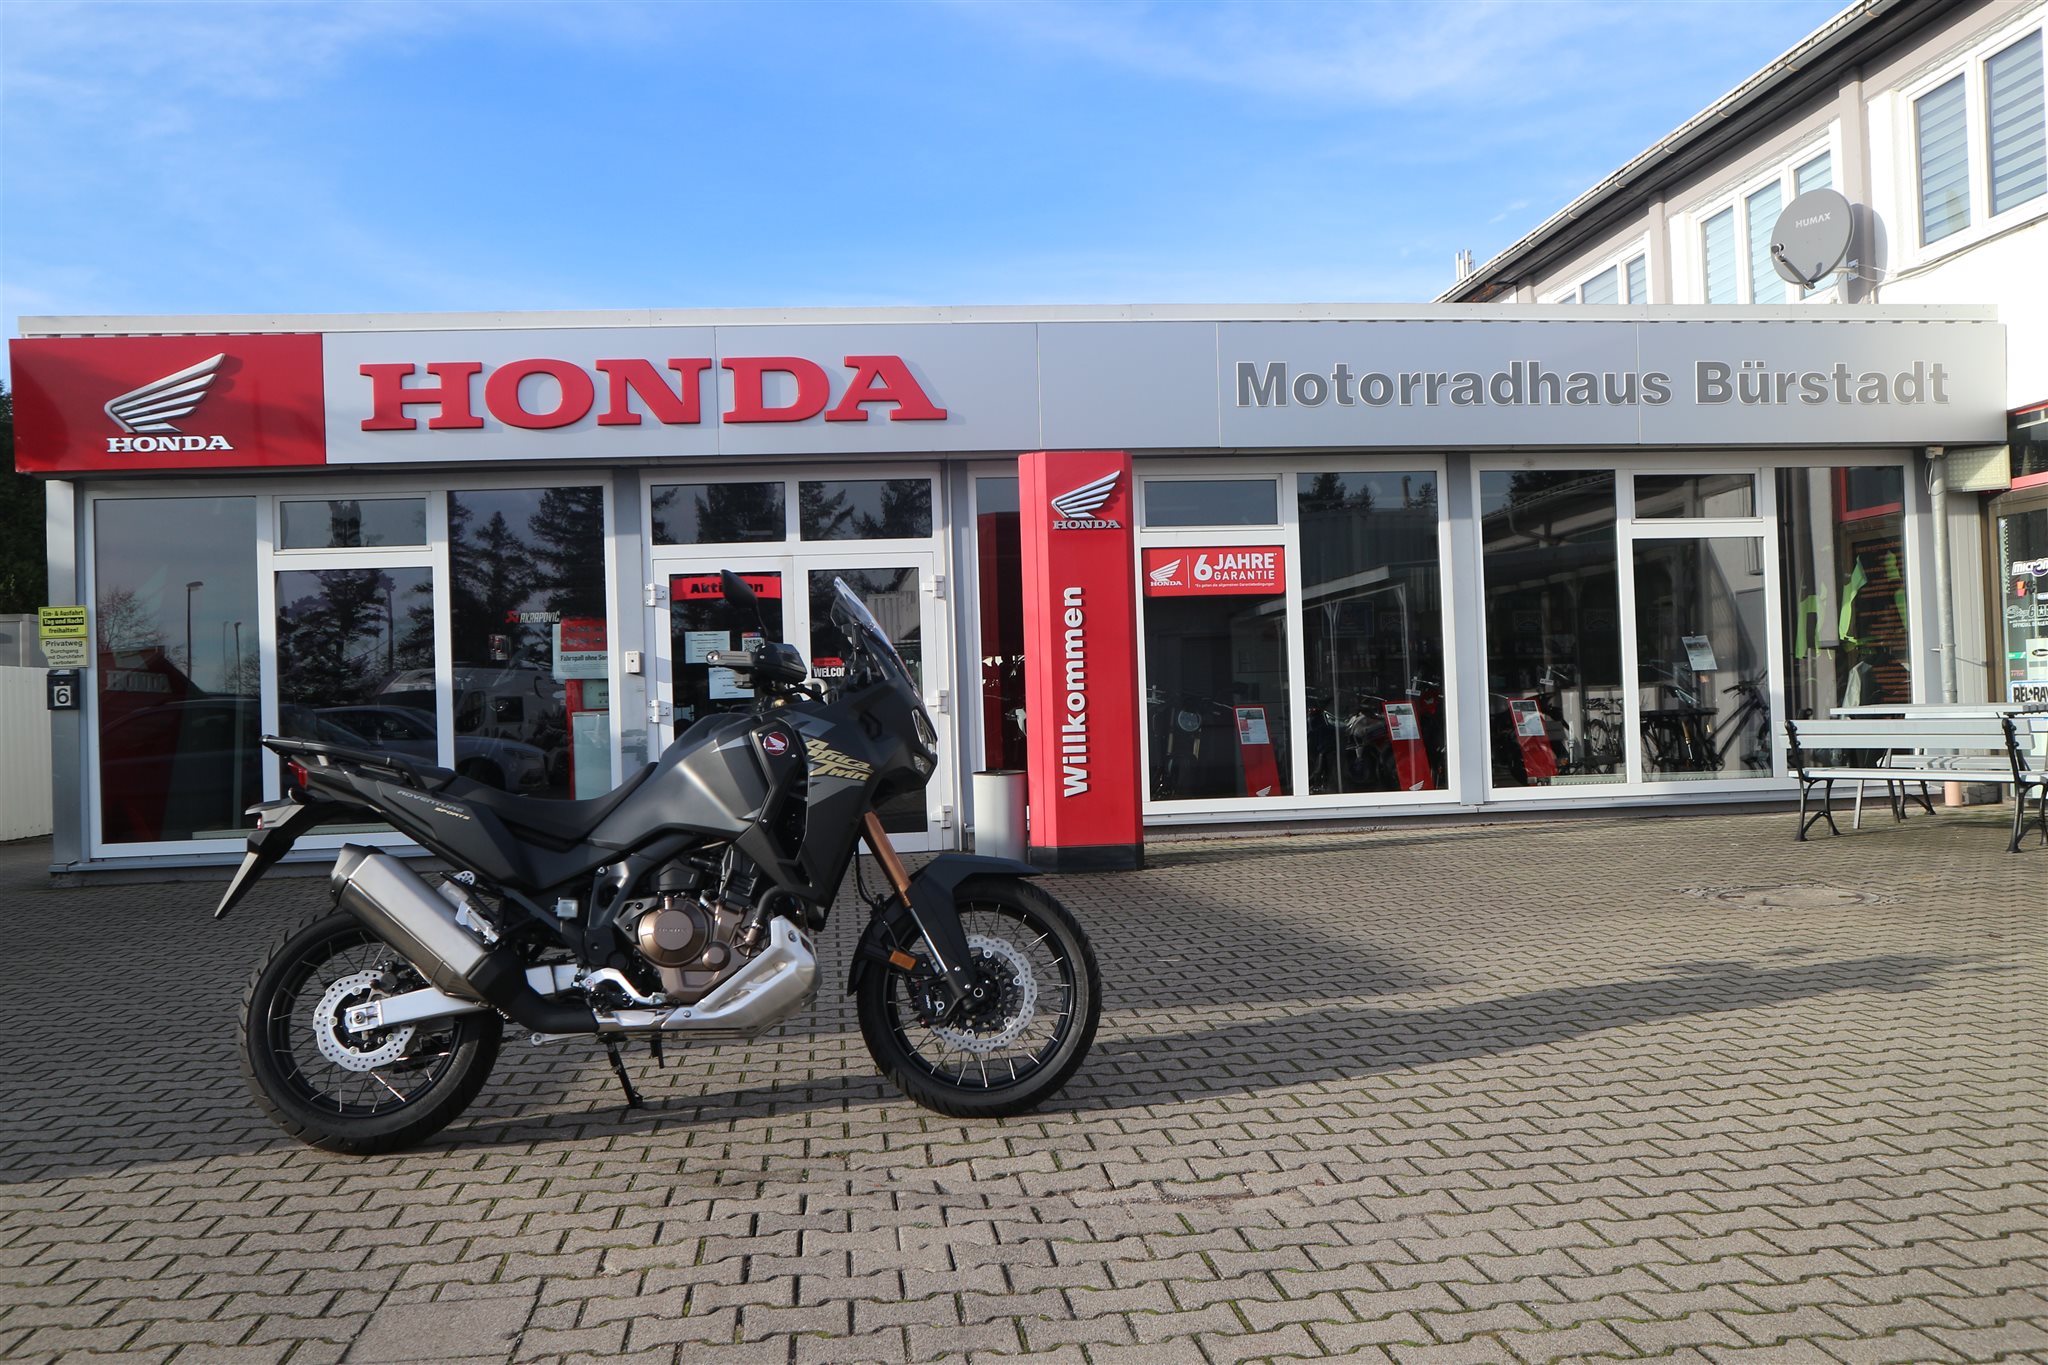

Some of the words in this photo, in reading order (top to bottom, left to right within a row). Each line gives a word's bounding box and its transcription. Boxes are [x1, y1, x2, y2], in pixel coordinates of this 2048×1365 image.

[1794, 212, 1831, 229] HUMAX
[1235, 360, 1673, 408] Motorradhaus
[1695, 359, 1951, 407] Bürstadt
[359, 355, 948, 432] HONDA
[106, 435, 234, 453] HONDA
[1052, 519, 1121, 530] HONDA
[1193, 554, 1213, 581] 6
[1213, 570, 1275, 581] GARANTIE
[690, 582, 764, 594] Aktin
[1150, 580, 1183, 588] HONDA
[45, 640, 83, 648] Privatweg
[56, 687, 70, 705] 6
[1062, 586, 1088, 798] Willkommen
[805, 739, 871, 770] Africa
[808, 759, 874, 781] Twin
[396, 789, 465, 813] ADVENTURE
[434, 806, 472, 821] SPORTS
